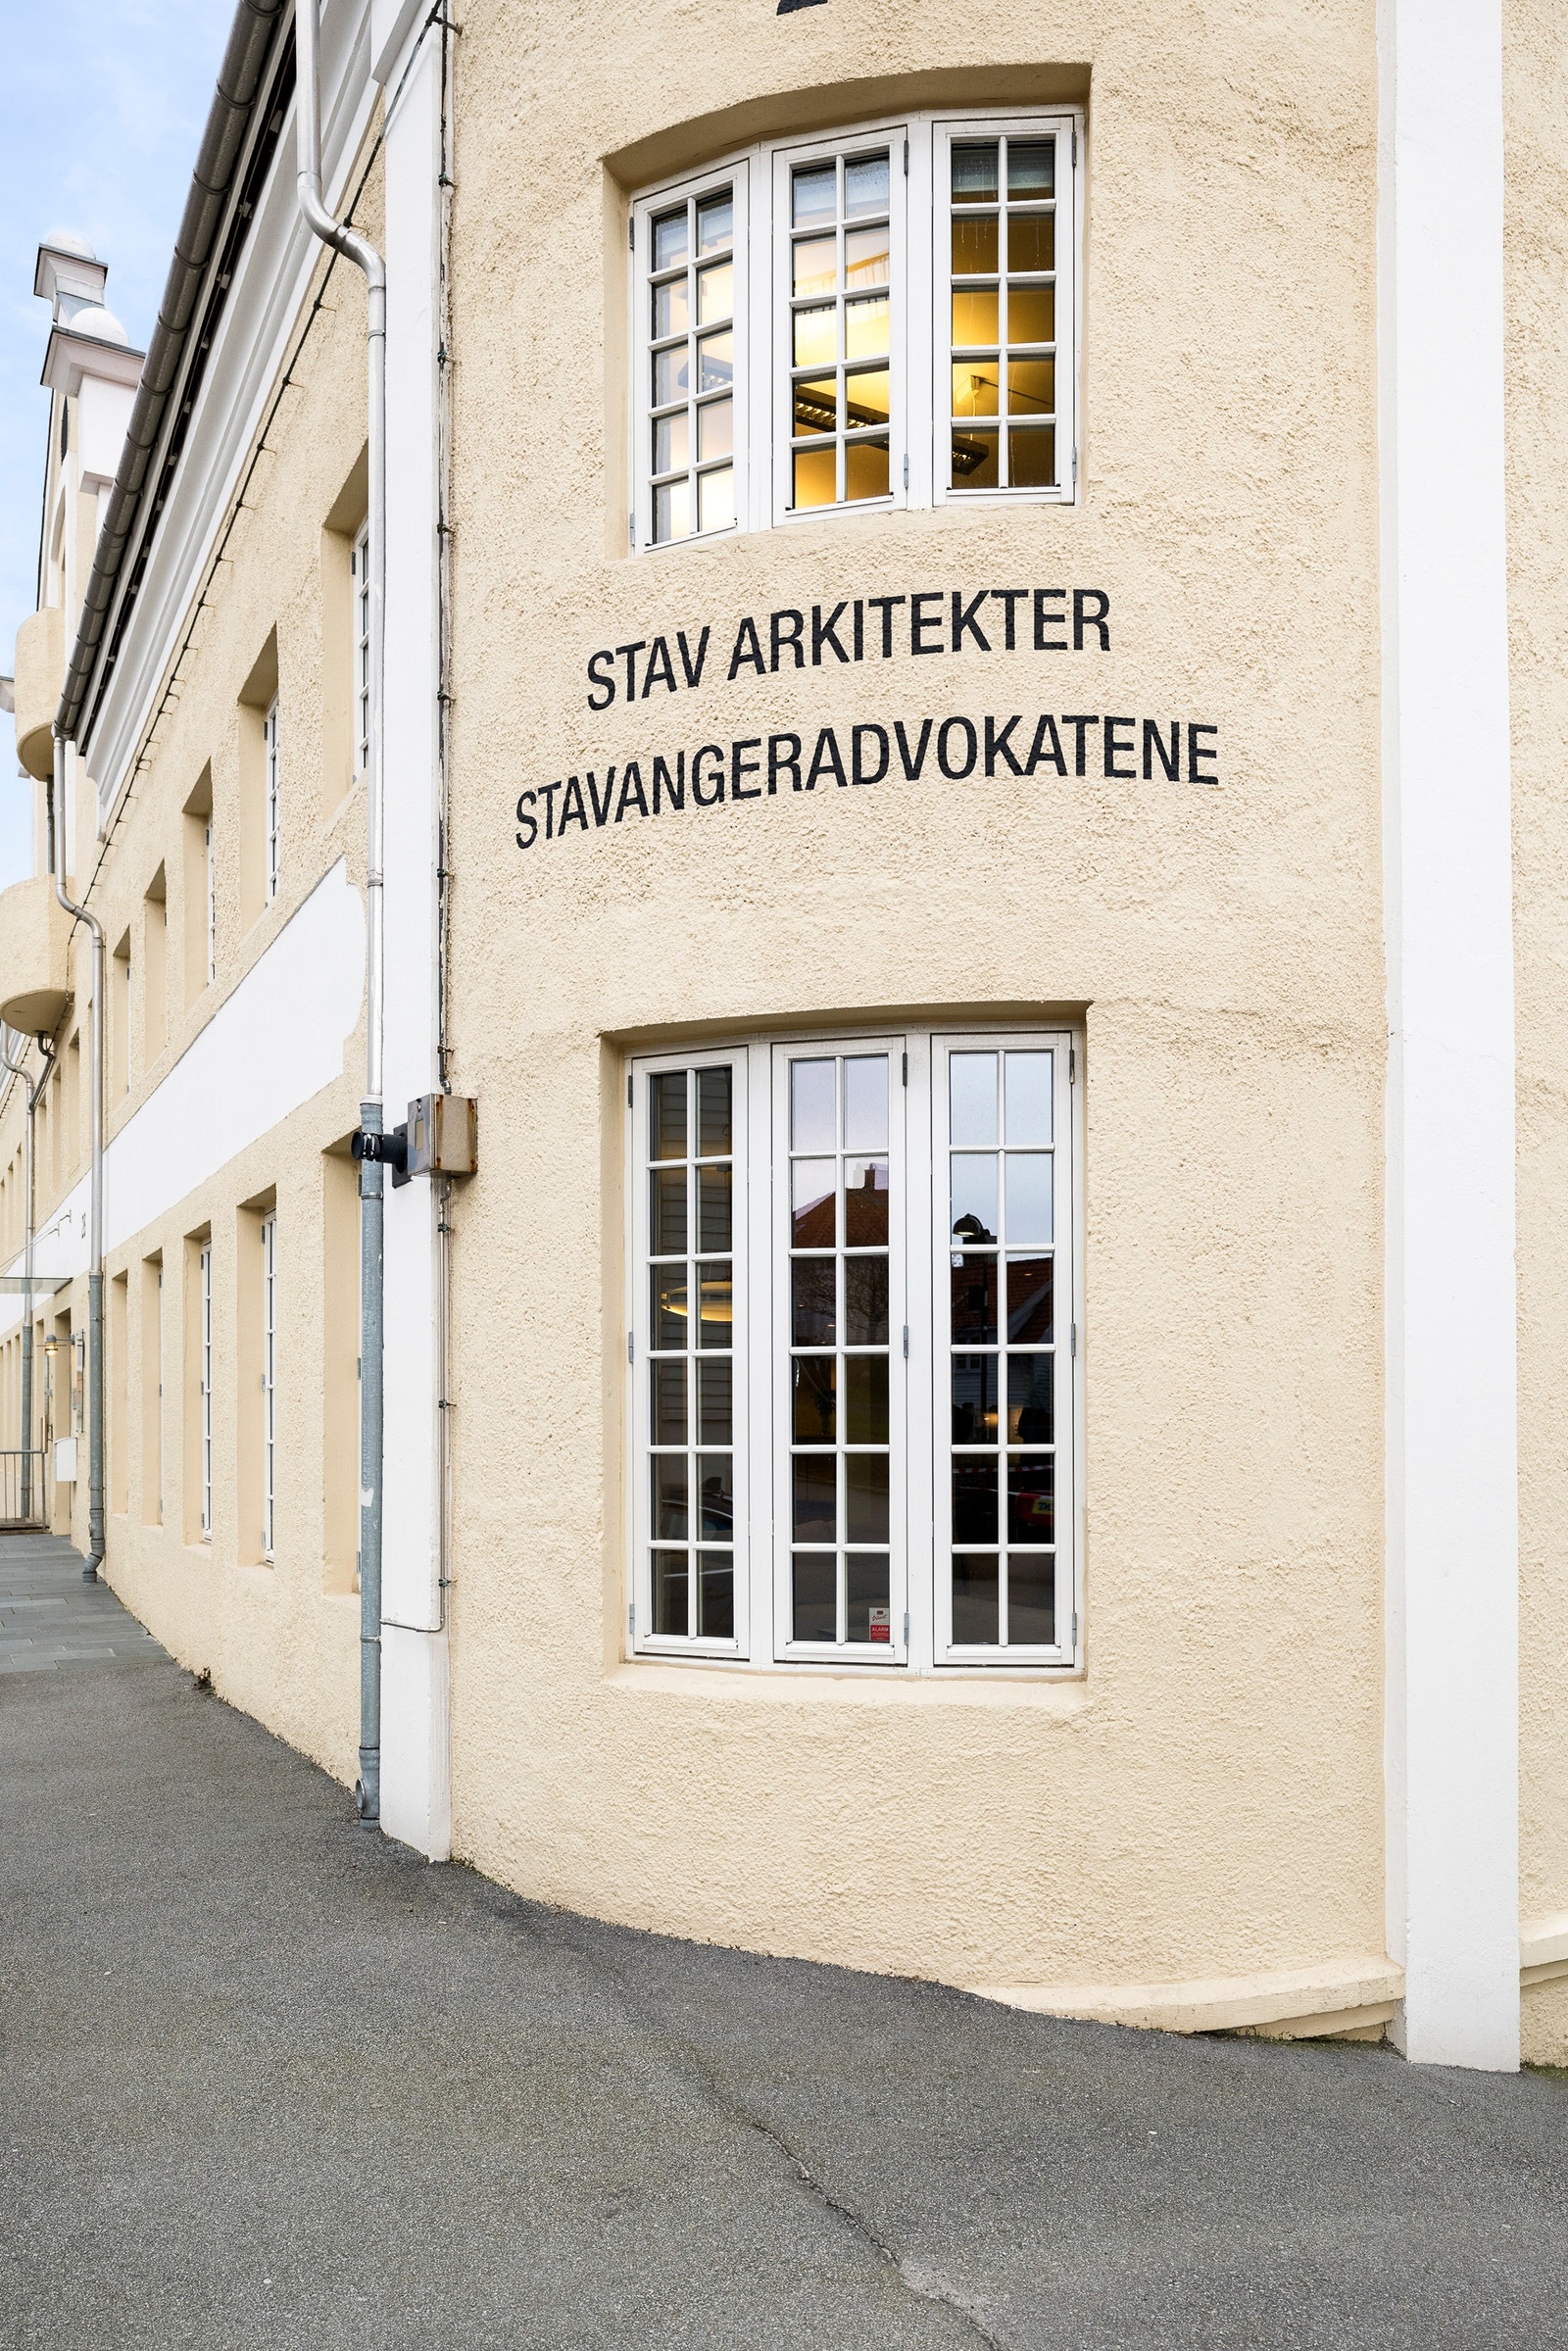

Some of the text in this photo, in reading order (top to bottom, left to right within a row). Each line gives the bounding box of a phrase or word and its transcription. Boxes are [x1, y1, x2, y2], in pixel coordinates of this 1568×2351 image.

[587, 588, 1111, 711] STAV ARKITEKTER
[515, 714, 1219, 850] STAVANGERADVOKATENE
